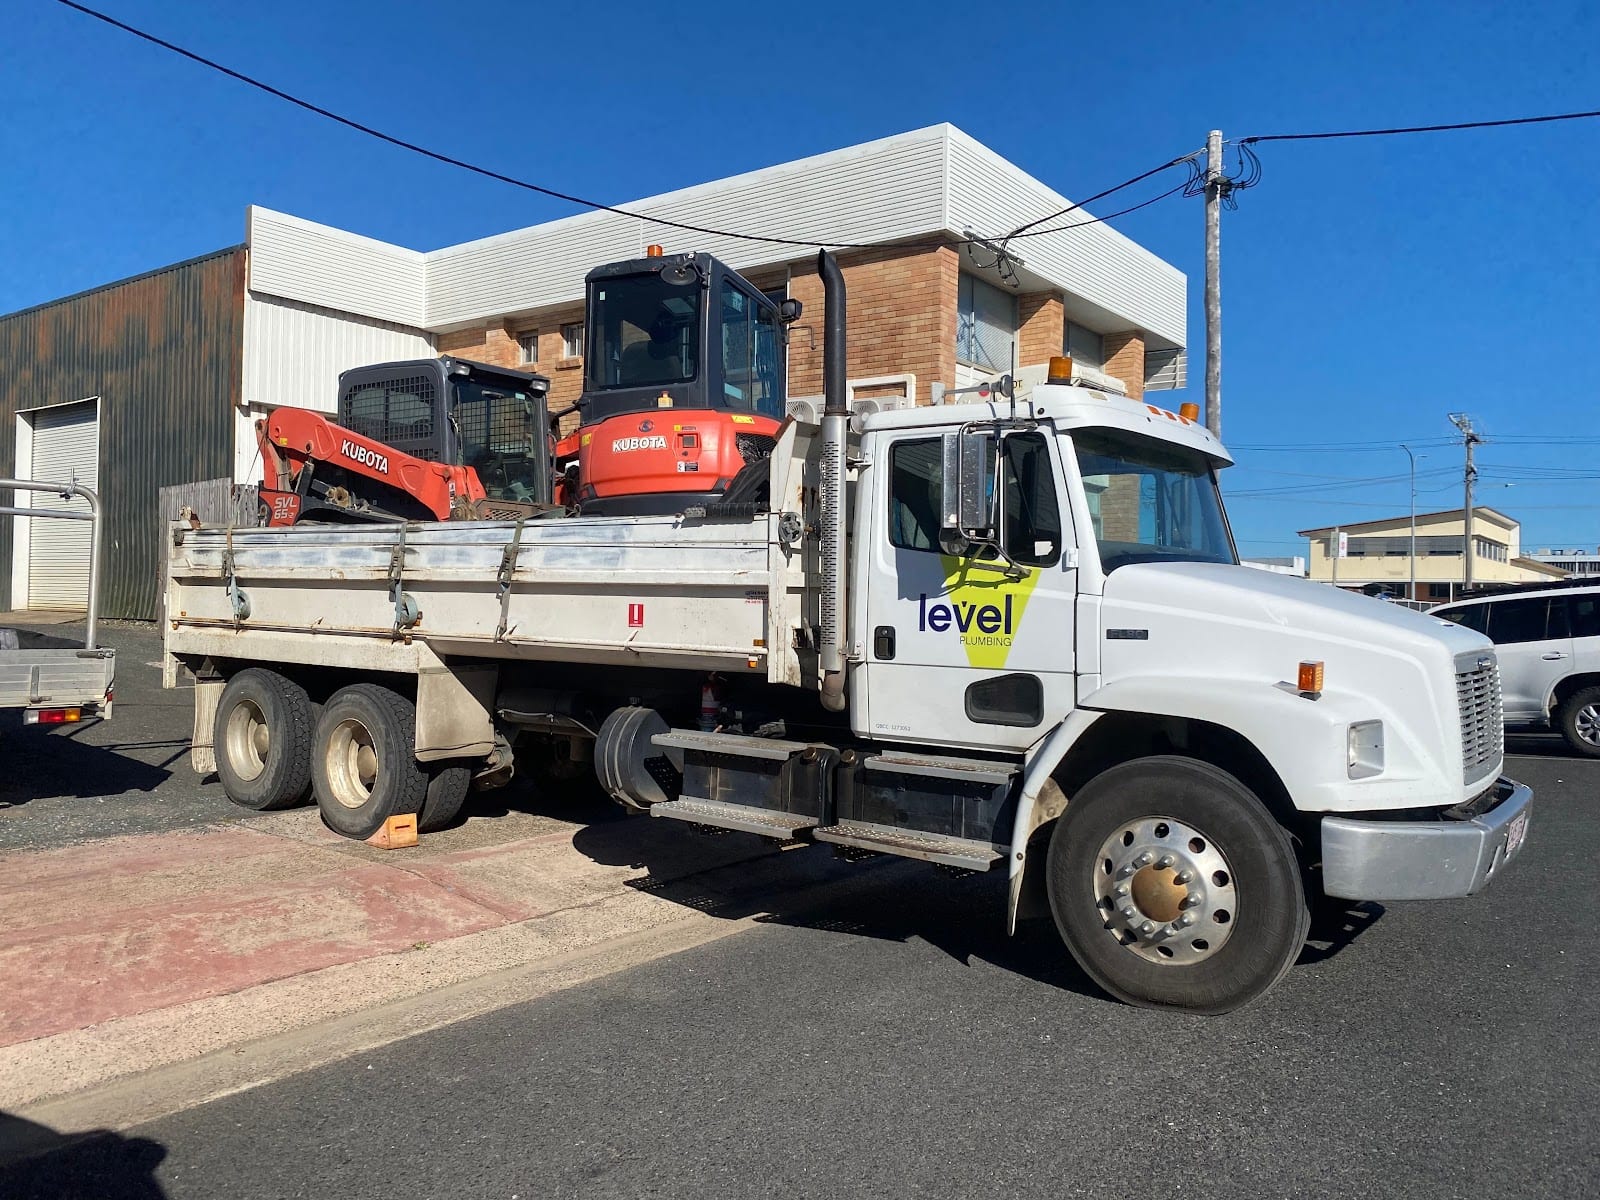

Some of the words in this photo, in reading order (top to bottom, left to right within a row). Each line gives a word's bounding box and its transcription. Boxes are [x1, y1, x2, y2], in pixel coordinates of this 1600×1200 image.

[612, 435, 667, 453] KUBOTA
[340, 438, 389, 475] KUBOTA
[274, 496, 297, 509] SVL
[919, 593, 1013, 635] level
[959, 635, 1012, 647] PLUMBING
